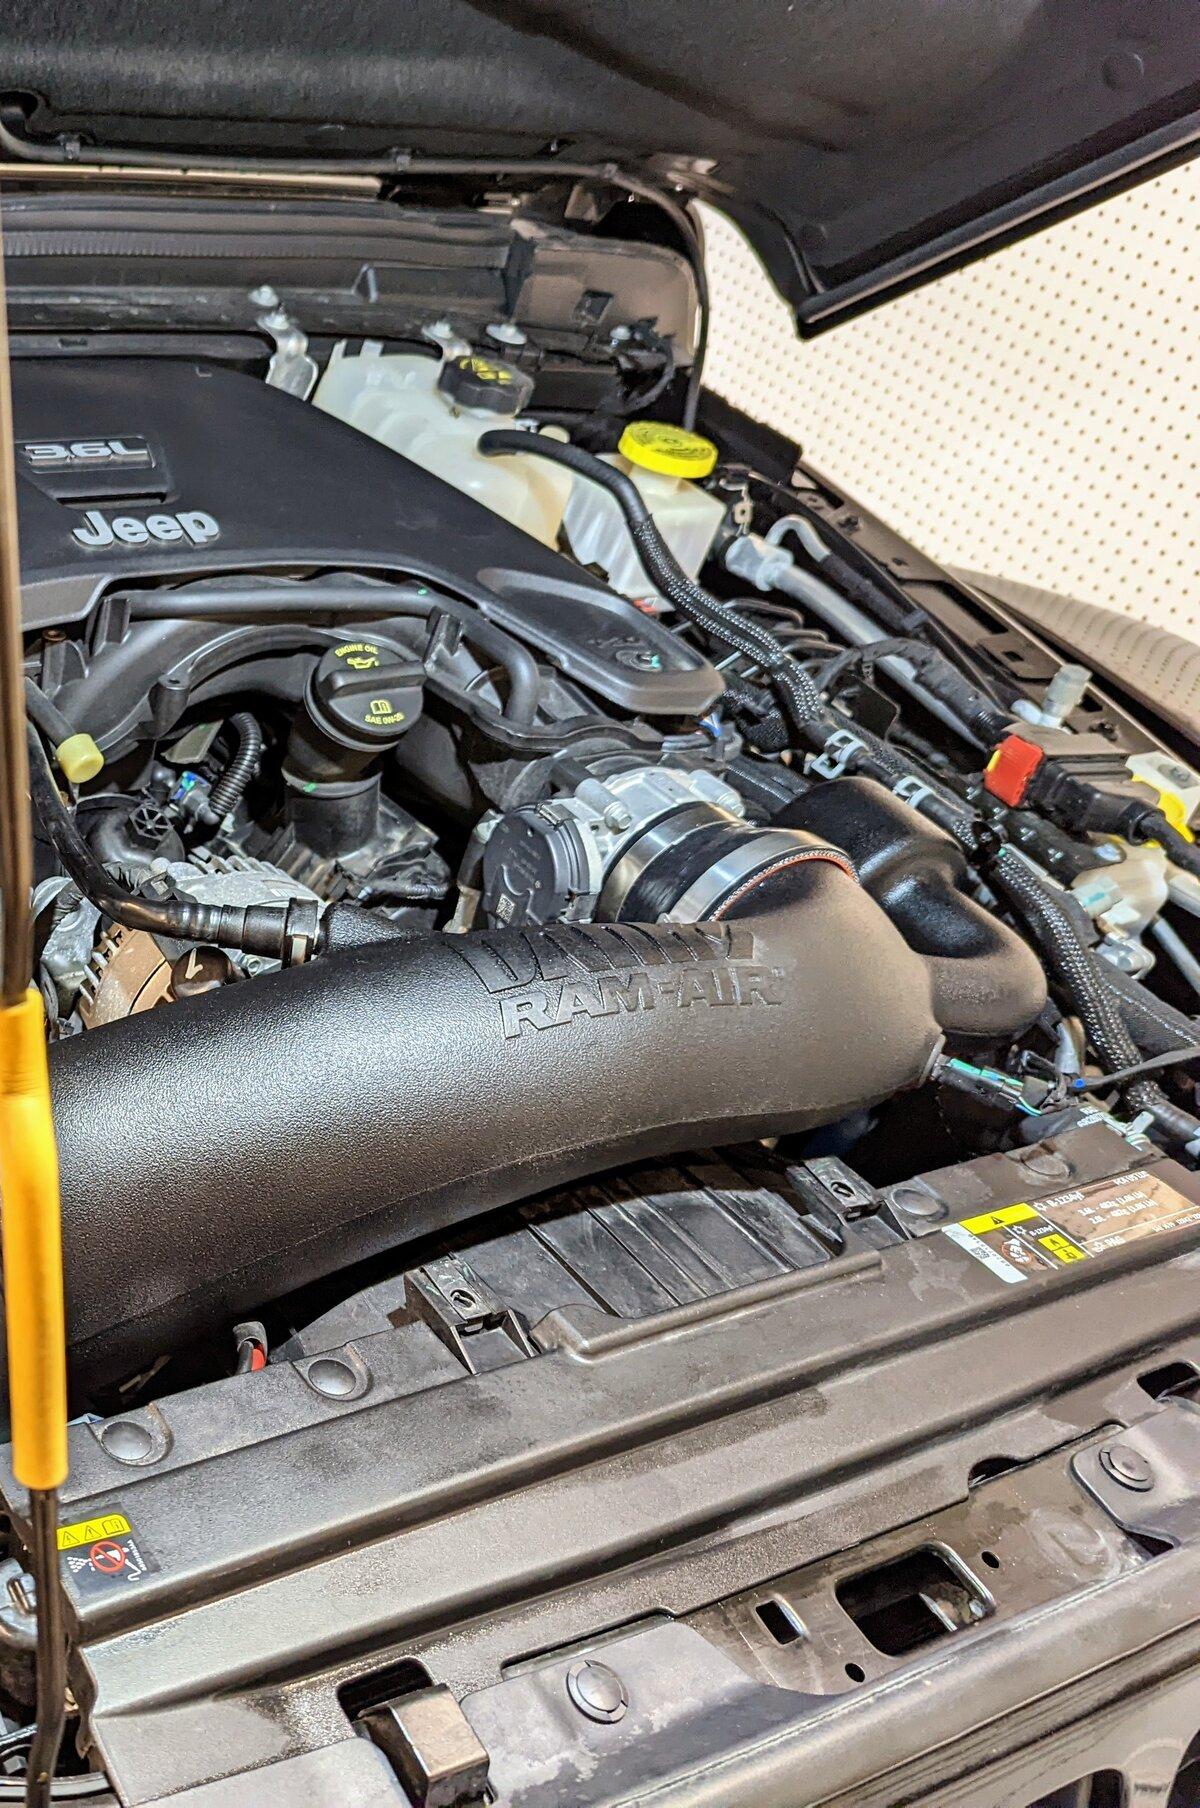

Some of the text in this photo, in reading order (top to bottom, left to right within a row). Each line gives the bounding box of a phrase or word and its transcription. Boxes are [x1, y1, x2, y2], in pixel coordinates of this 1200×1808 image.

[25, 439, 148, 462] 3.6L
[72, 510, 220, 547] Jeep
[334, 643, 379, 657] ENGINE OIL
[365, 714, 382, 725] SAE
[1046, 1191, 1085, 1207] R-1234yf
